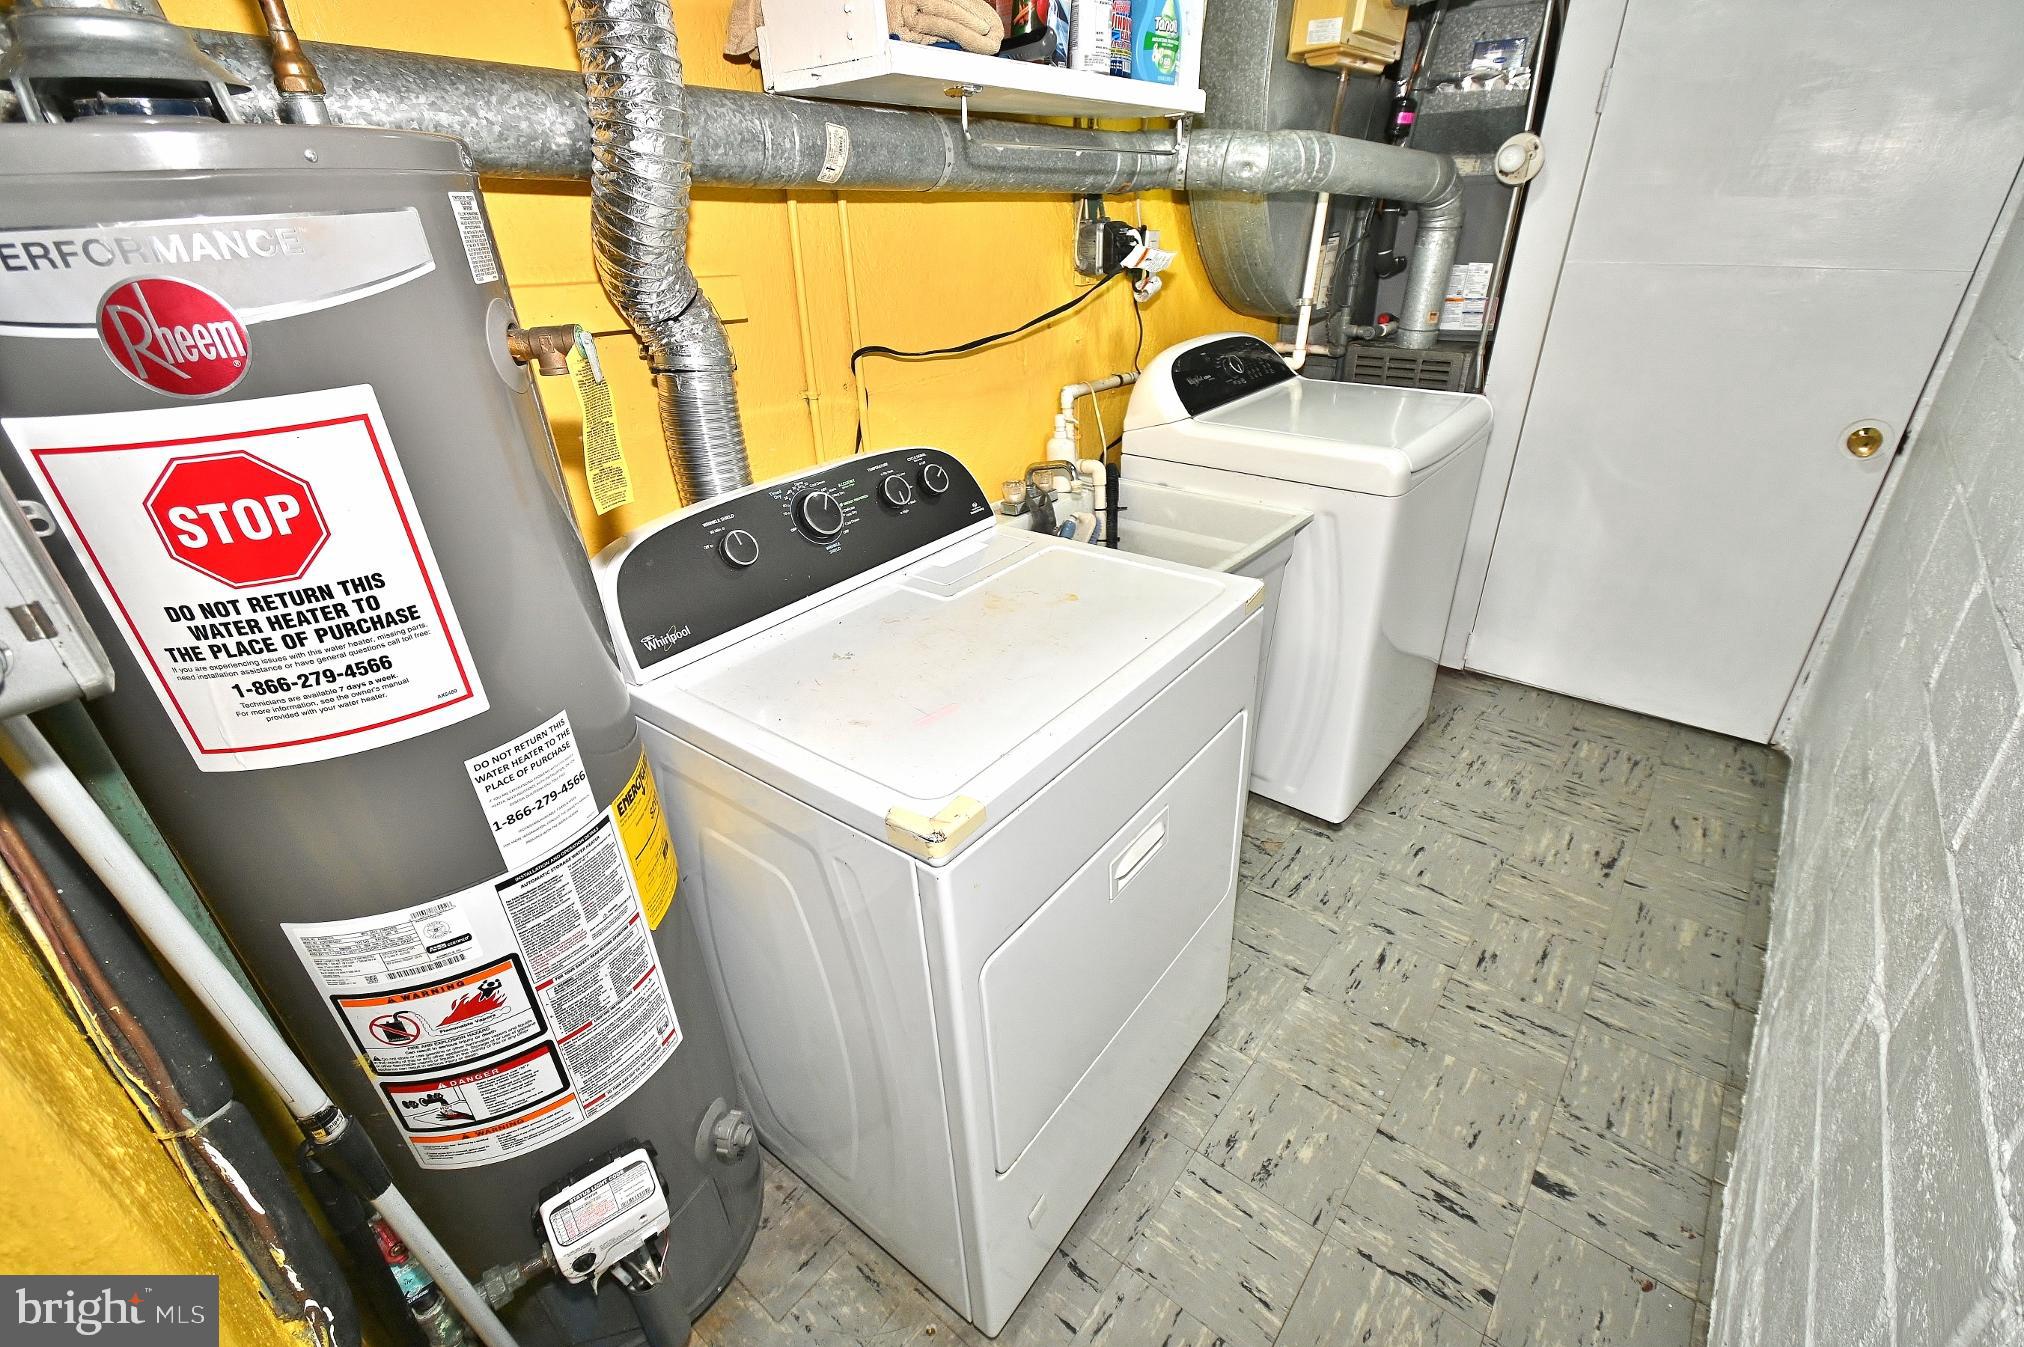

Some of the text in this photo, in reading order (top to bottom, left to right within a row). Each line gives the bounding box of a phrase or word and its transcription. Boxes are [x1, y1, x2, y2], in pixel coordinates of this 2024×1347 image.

[0, 227, 305, 272] ERFORMANCE
[106, 282, 246, 379] Rheem
[168, 494, 300, 548] STOP
[164, 572, 386, 622] DO NOT RETURN THIS
[187, 595, 380, 641] WATER HEATER TO
[164, 604, 421, 662] THE PLACE OF PURCHASE
[179, 666, 193, 674] you
[209, 660, 260, 671] experiencing
[261, 656, 288, 664] issues
[289, 651, 306, 660] with
[308, 647, 323, 658] this
[324, 643, 346, 654] water
[348, 637, 374, 647] heater,
[377, 628, 406, 641] missing
[198, 670, 239, 680] installation
[241, 665, 282, 676] assistance
[295, 658, 314, 668] have
[317, 652, 346, 664] general
[349, 642, 386, 658] questions
[388, 638, 400, 646] call
[414, 629, 431, 640] free:
[643, 625, 691, 651] Whirlpool
[232, 655, 392, 698] 1-866-279-4566
[240, 698, 286, 709] Technicians
[288, 695, 300, 703] are
[302, 688, 337, 700] available
[346, 680, 367, 691] days
[375, 673, 399, 684] week.
[251, 708, 271, 716] more
[272, 700, 319, 712] information,
[337, 693, 349, 702] the
[351, 686, 381, 698] owner's
[382, 678, 409, 690] manual
[266, 694, 387, 722] provided with your water heater.
[474, 718, 565, 772] DO NOT RETURN THIS
[474, 728, 571, 784] WATER HEATER TO THE
[485, 740, 571, 792] PLACE OF PURCHASE
[493, 770, 586, 832] 1-866-279-4566
[514, 858, 550, 882] INSTALLATION
[520, 836, 600, 889] AUTOMATIC STORAGE WATER HEATER
[402, 980, 465, 1001] WARNING
[450, 1068, 500, 1087] DANGER
[476, 1119, 525, 1137] WARNING
